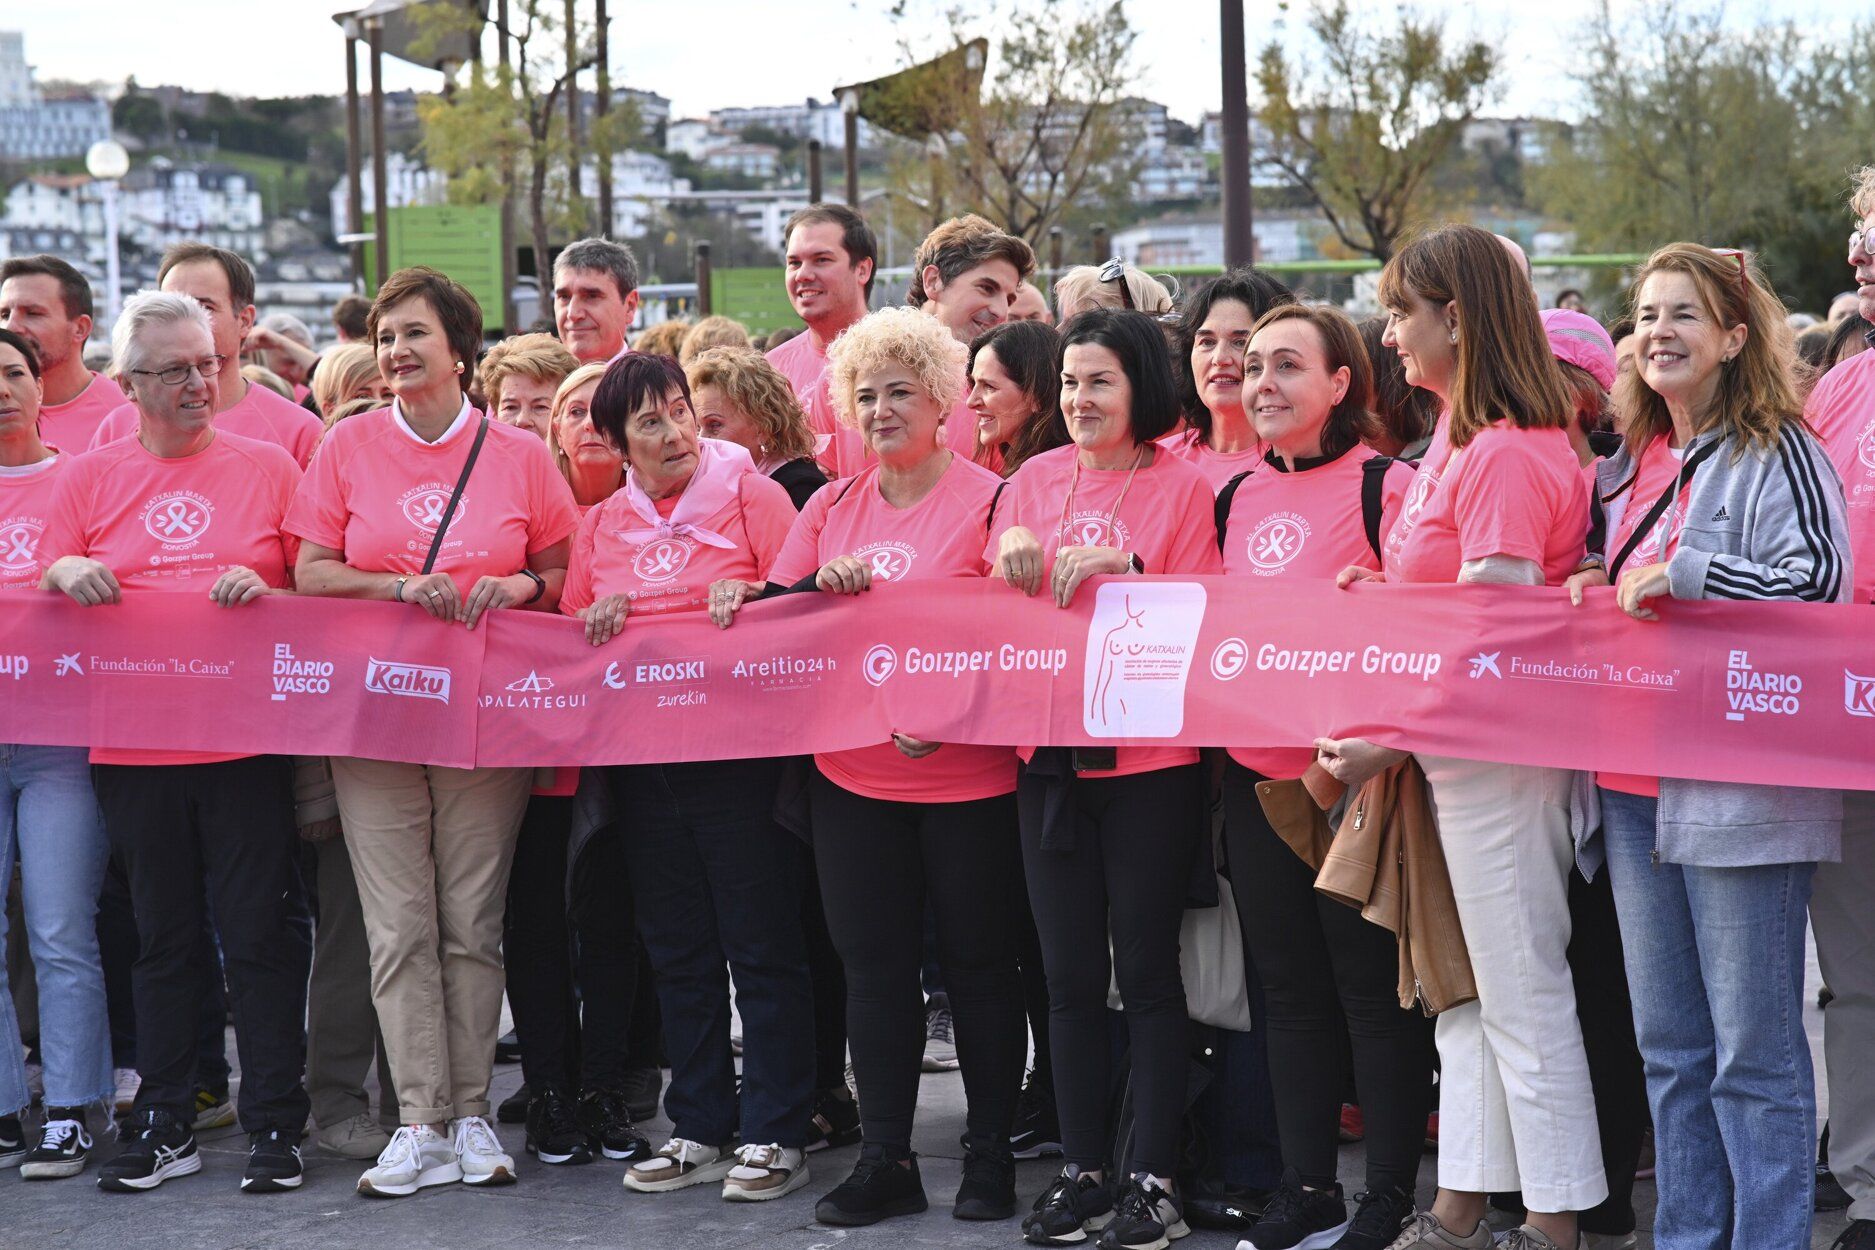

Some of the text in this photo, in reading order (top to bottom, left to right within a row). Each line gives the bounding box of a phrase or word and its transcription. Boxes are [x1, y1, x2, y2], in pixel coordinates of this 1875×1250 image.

[144, 490, 183, 510] KATXALIN
[185, 490, 216, 513] MARTXA
[1063, 510, 1102, 527] KTXALIN
[1254, 511, 1290, 531] KATXALIN
[1290, 512, 1312, 538] MARTXA
[160, 540, 200, 551] DONOSTIA
[852, 540, 918, 559] KATXALIN MARTXA
[1252, 566, 1286, 577] DONOSTIA
[274, 644, 294, 658] EL
[999, 643, 1067, 676] Group
[1146, 645, 1186, 655] KATXALIN
[1728, 650, 1752, 669] EL
[91, 656, 166, 674] Fundación
[273, 659, 334, 677] DIARIO
[635, 660, 705, 683] EROSKI
[732, 656, 806, 678] Areitio
[1362, 645, 1442, 681] Group
[1510, 657, 1598, 680] Fundación
[273, 677, 330, 694] VASCO
[372, 665, 445, 695] Kaiku
[750, 676, 822, 686] FARMACIA
[1726, 670, 1802, 694] DIARIO
[478, 694, 587, 709] APALATEGUI
[656, 689, 707, 708] zurekin
[1727, 691, 1799, 715] VASCO
